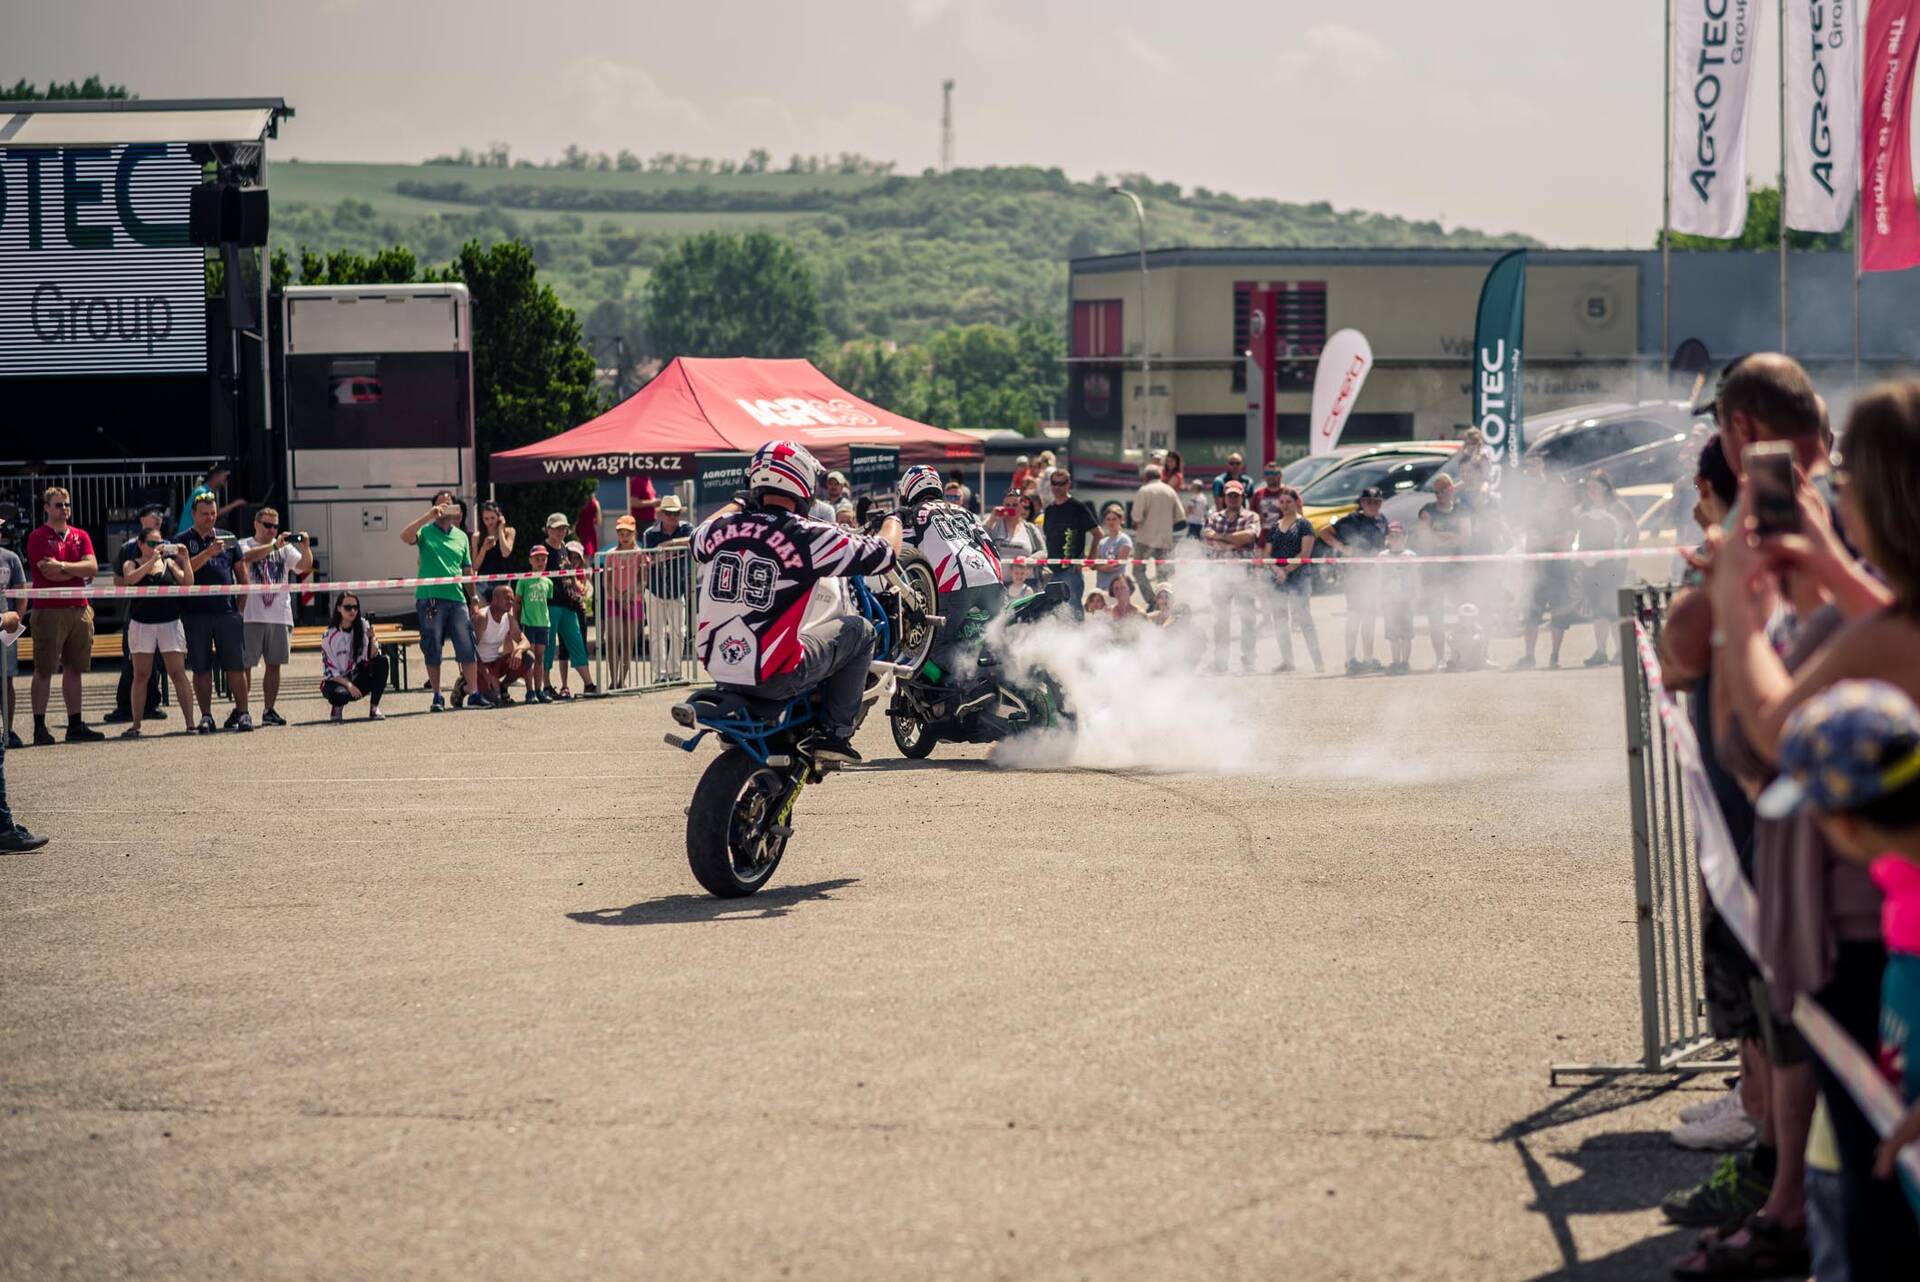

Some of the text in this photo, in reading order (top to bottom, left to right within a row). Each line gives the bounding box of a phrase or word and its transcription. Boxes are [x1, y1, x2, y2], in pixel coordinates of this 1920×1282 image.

[1810, 0, 1834, 198] AGROTE
[0, 143, 190, 249] TEC
[31, 282, 172, 354] Group
[543, 454, 682, 475] www.agrics.cz
[702, 468, 742, 479] AGROTEC
[705, 522, 804, 569] CRAZY DAY
[709, 550, 780, 613] 09
